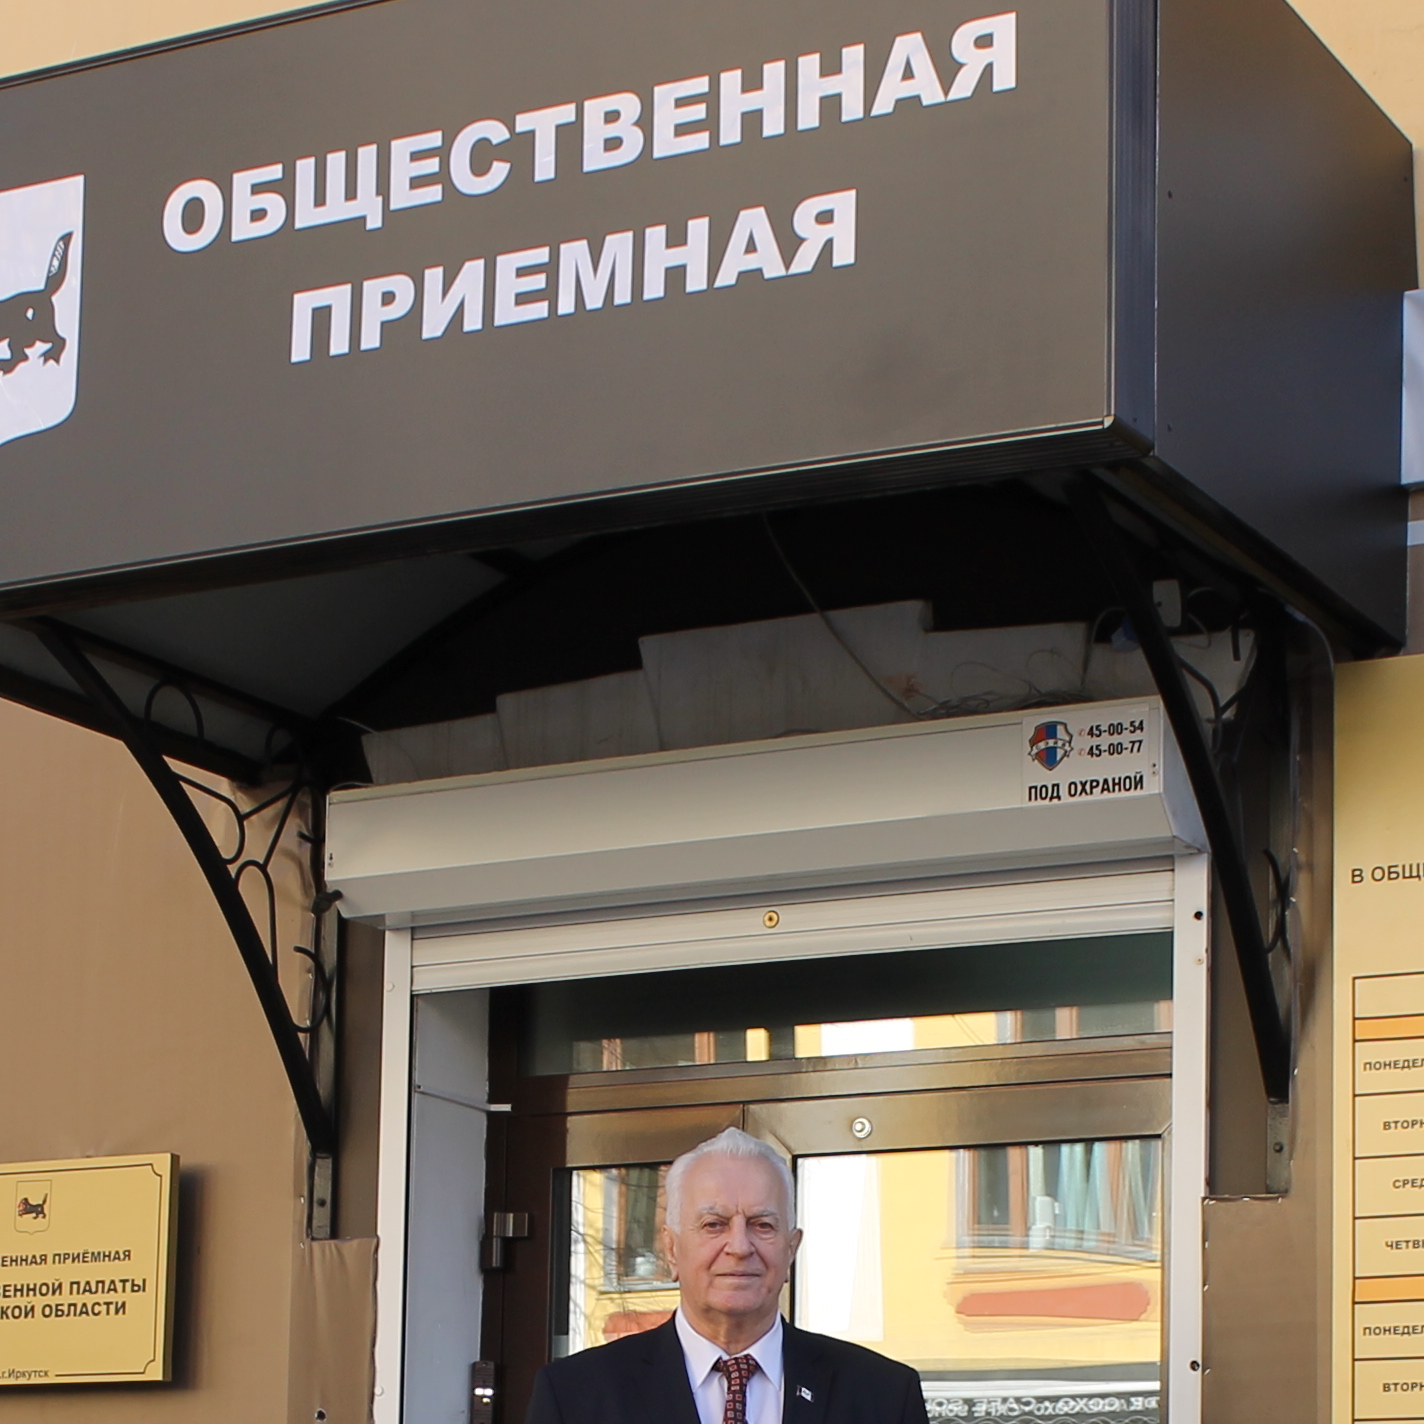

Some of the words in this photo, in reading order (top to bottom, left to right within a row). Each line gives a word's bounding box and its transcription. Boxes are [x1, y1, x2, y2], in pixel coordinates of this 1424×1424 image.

[162, 12, 1018, 254] ОБЩЕСТВЕННАЯ
[290, 189, 857, 364] ПРИЕМНАЯ
[1087, 719, 1144, 738] 45-00-54
[1087, 739, 1144, 758] 45-00-77
[1028, 783, 1061, 802] ПОД
[1068, 772, 1144, 798] ОХРАНОЙ
[1351, 868, 1363, 884] В
[52, 1249, 130, 1264] ПРИЁМНАЯ
[69, 1278, 146, 1295] ПАЛАТЫ
[41, 1300, 126, 1318] ОБЛАСТИ
[1, 1369, 50, 1379] г.Иркутск
